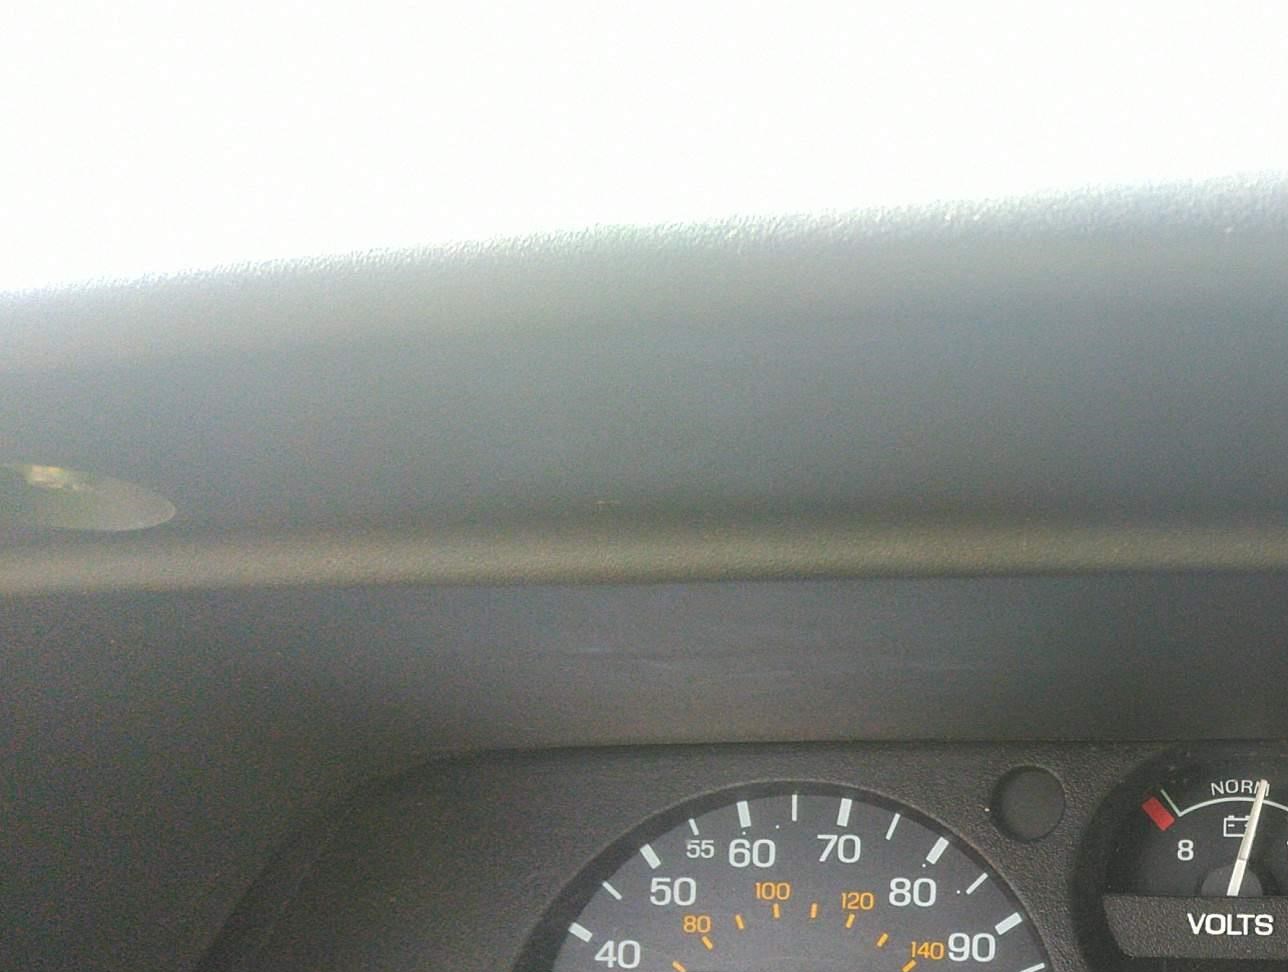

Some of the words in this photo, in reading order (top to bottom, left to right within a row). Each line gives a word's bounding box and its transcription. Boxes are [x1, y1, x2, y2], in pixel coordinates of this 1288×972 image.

[686, 839, 715, 858] 55
[728, 839, 776, 867] 60
[817, 834, 861, 863] 70
[1177, 840, 1194, 861] 8
[650, 877, 696, 906] 50
[755, 882, 790, 900] 100
[841, 892, 874, 910] 120
[889, 877, 936, 906] 80
[683, 915, 711, 933] 80
[1187, 913, 1273, 935] VOLTS
[594, 940, 641, 968] 40
[911, 941, 944, 960] 140
[948, 933, 995, 962] 90
